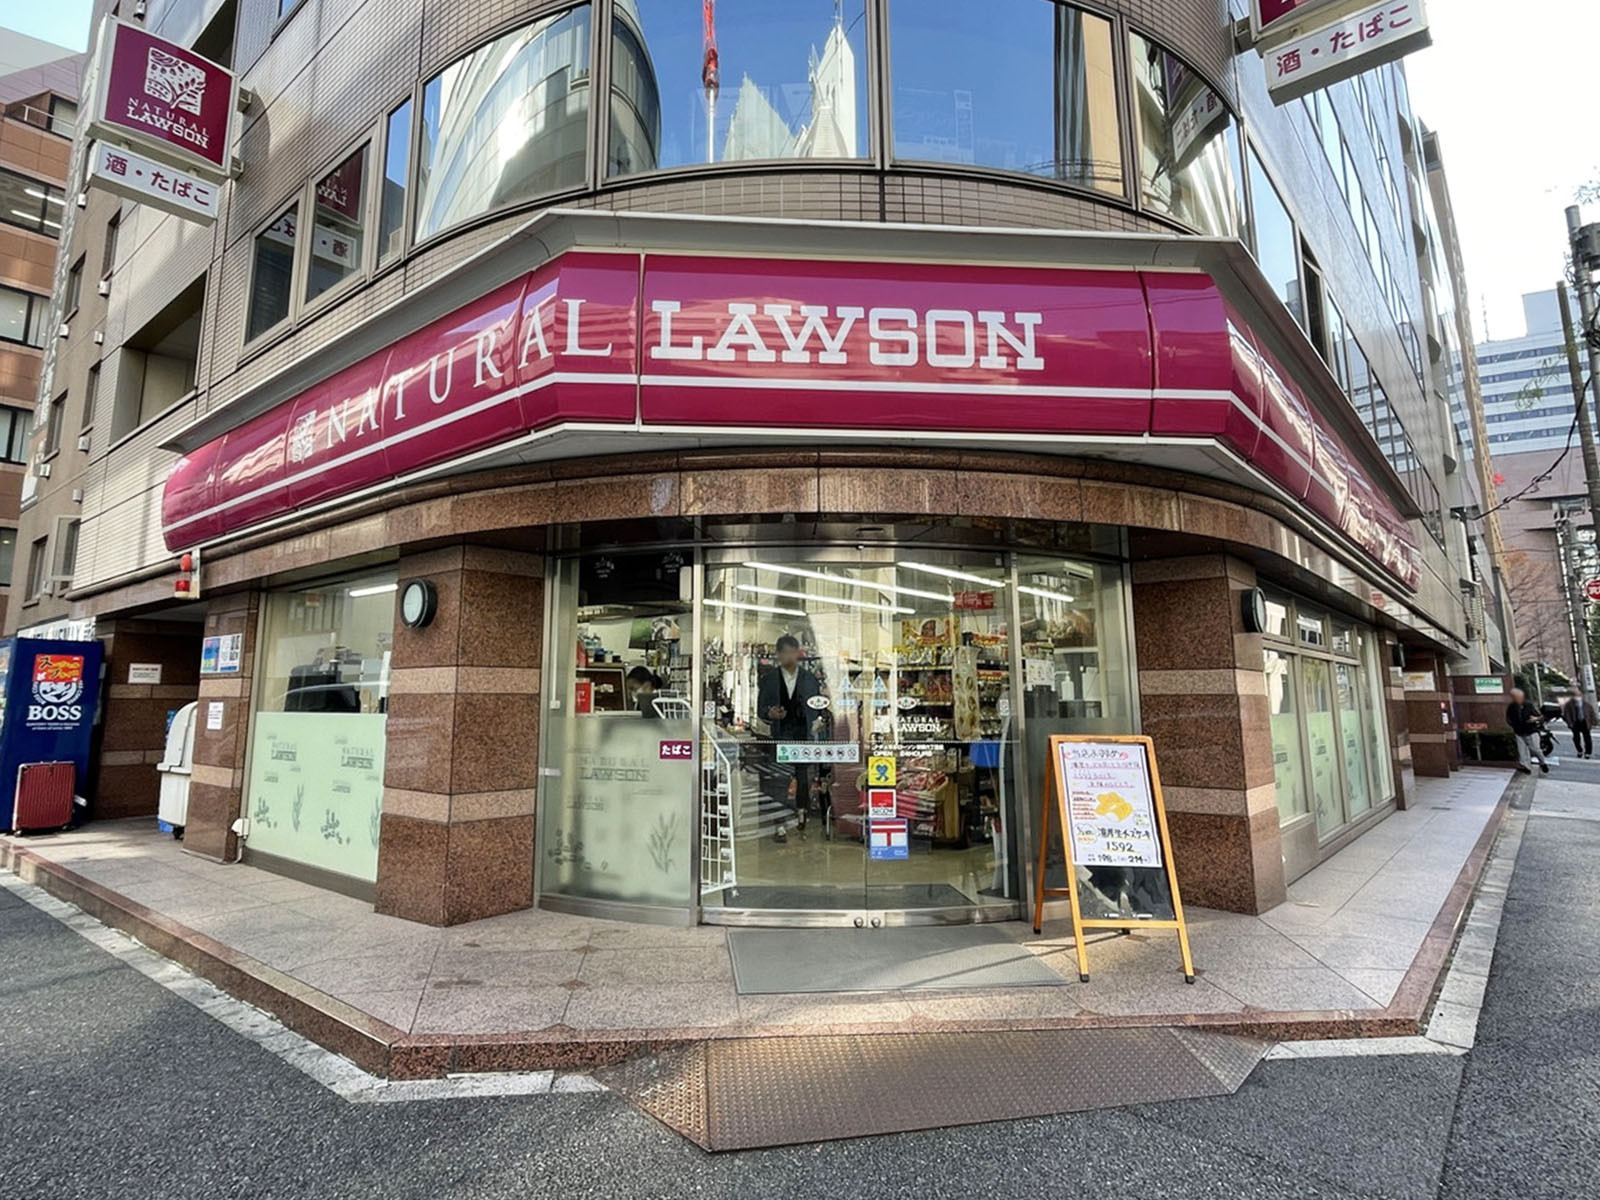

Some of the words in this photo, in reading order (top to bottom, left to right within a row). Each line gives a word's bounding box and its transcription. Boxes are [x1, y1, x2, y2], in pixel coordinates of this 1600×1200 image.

[1277, 5, 1412, 77] 酒・たばこ
[126, 106, 209, 149] LAWSON
[128, 97, 210, 138] NATURAL
[105, 152, 210, 206] 酒・たばこ
[326, 298, 612, 449] NATURAL
[651, 300, 1045, 370] LAWSON
[26, 705, 82, 720] BOSS
[661, 744, 691, 756] たばこ
[579, 766, 650, 782] LAWSON
